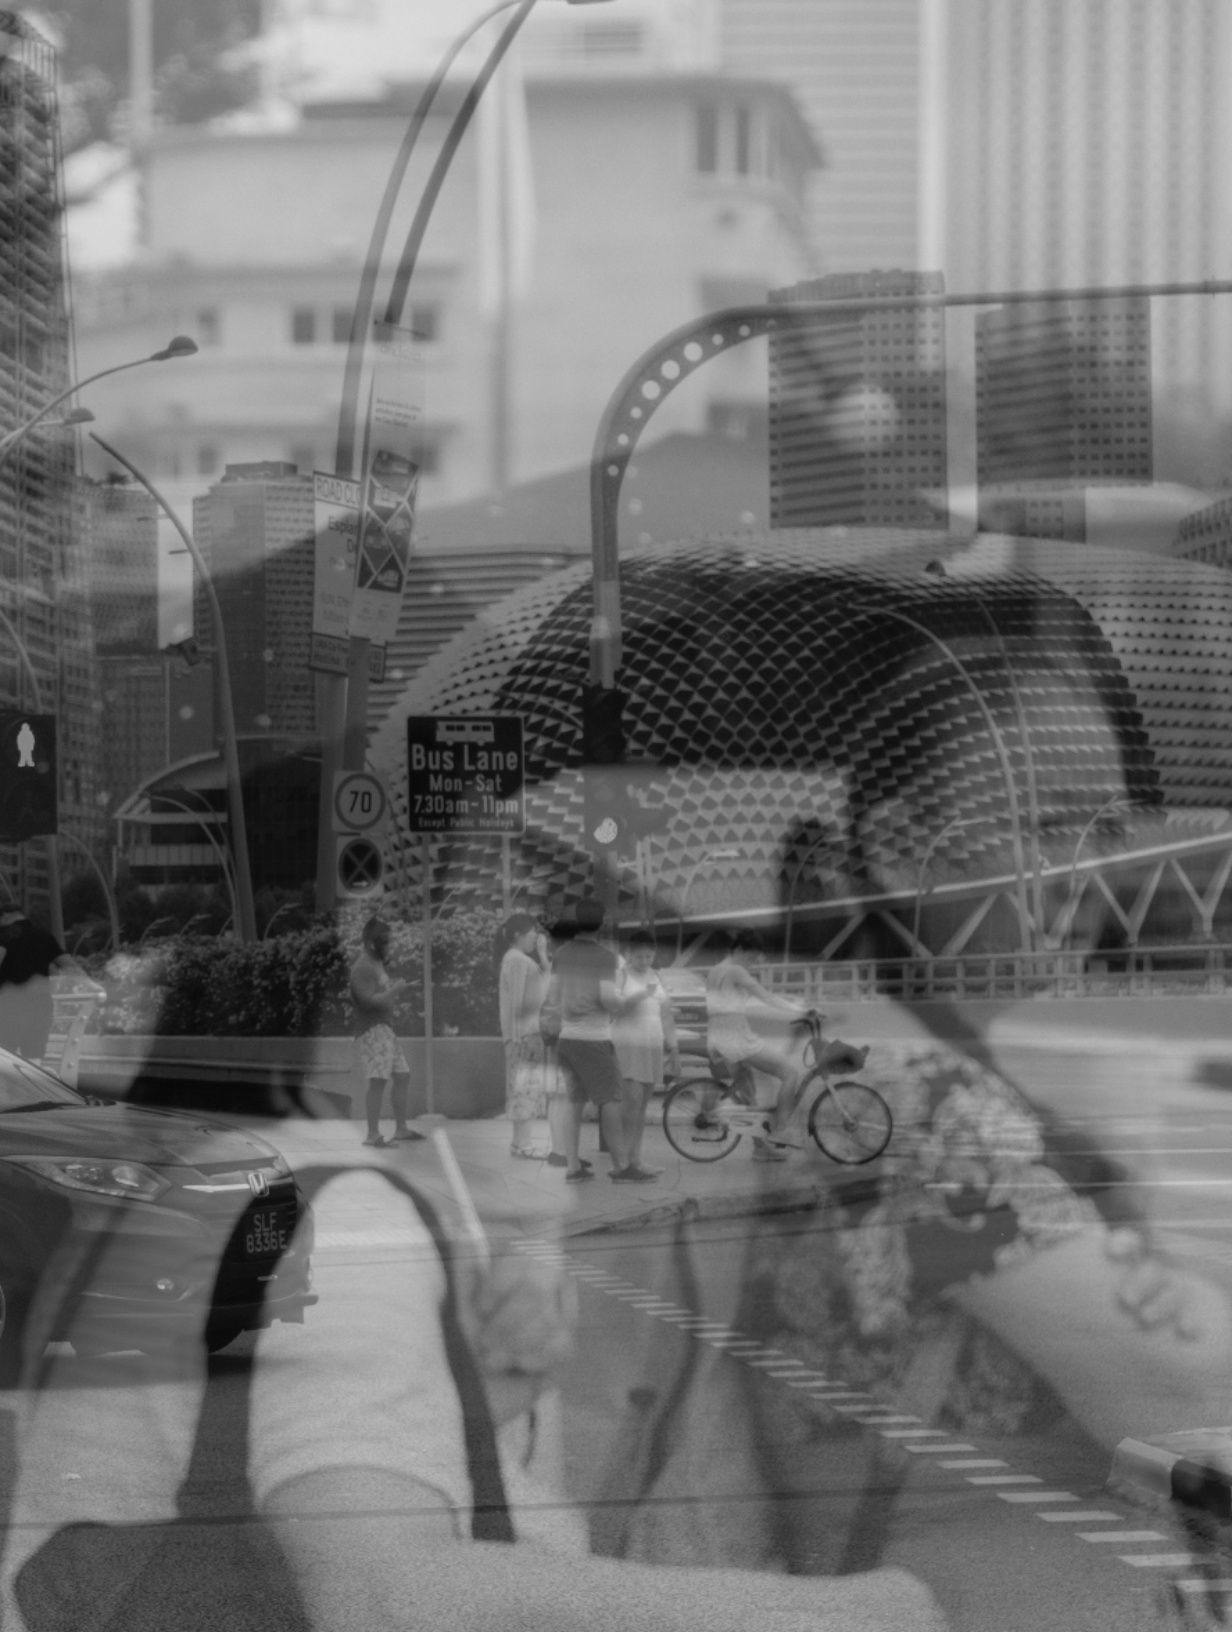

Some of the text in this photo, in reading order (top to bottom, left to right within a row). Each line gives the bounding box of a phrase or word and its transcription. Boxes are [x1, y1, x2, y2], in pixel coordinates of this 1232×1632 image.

[412, 743, 518, 771] Bus Lane
[349, 790, 373, 813] 70
[253, 1212, 277, 1233] SLF
